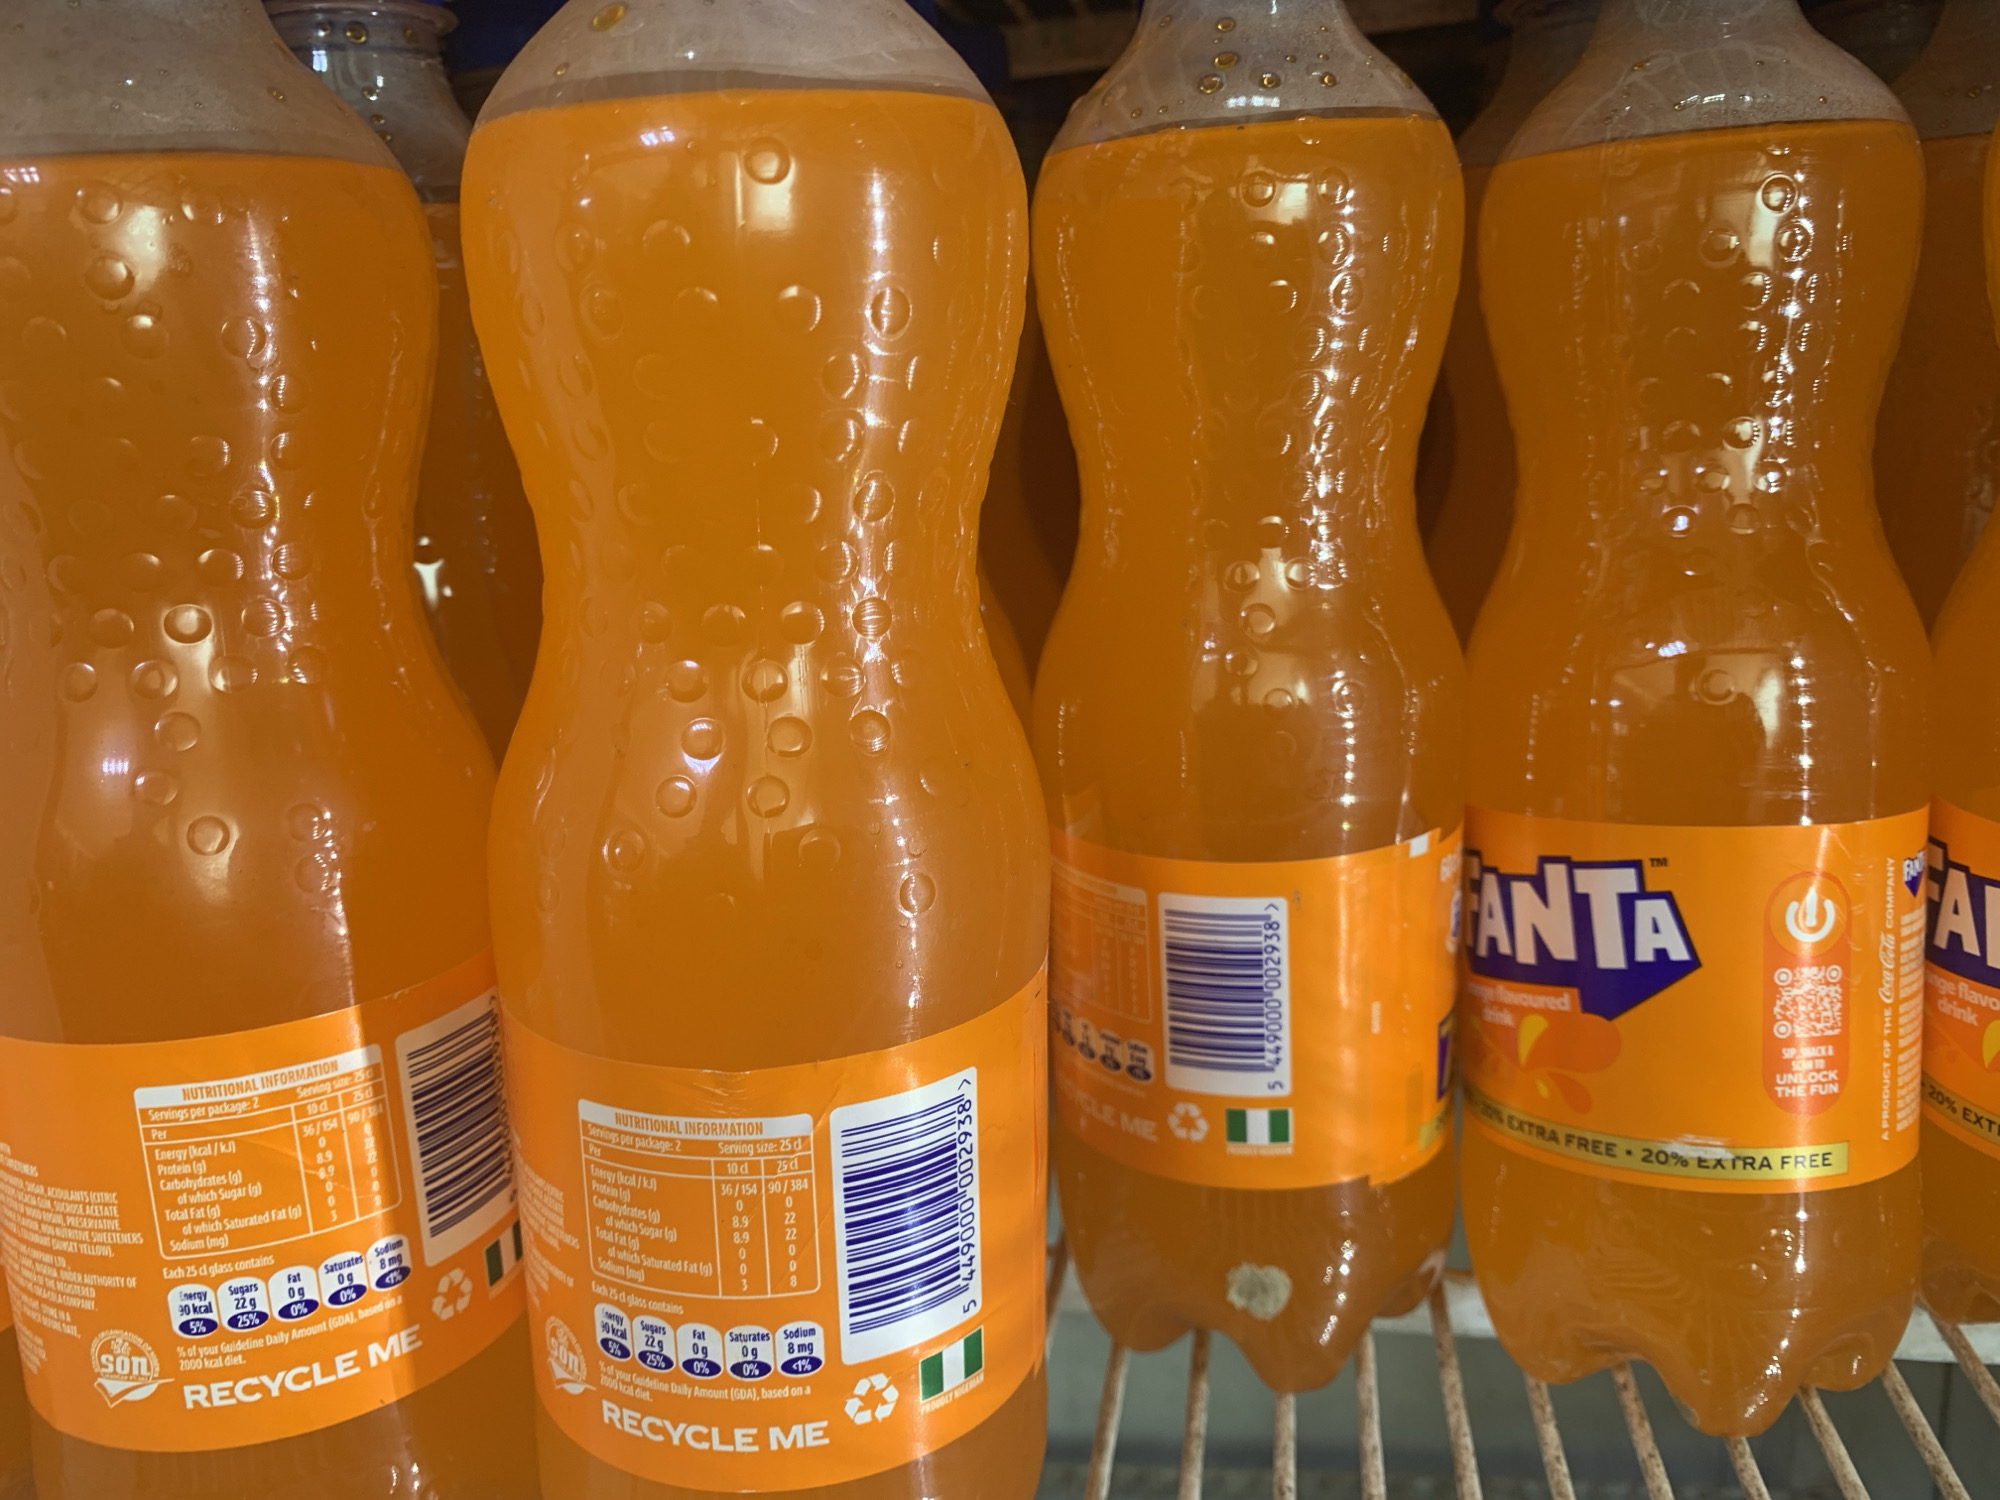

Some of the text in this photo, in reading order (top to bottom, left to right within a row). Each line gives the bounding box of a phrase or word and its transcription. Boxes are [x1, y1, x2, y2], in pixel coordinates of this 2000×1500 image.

[1649, 858, 1668, 867] TM
[1885, 857, 1895, 928] COMPANY
[1496, 983, 1571, 1011] flavoured
[1937, 996, 1979, 1027] drink
[1884, 1007, 1893, 1036] THE
[1883, 1040, 1892, 1058] OF
[182, 1060, 338, 1100] NUTRITIONAL INFORMATION
[1775, 1069, 1838, 1085] UNLOCK
[296, 1082, 332, 1099] Serving
[1774, 1082, 1839, 1098] THE FUN
[1881, 1062, 1891, 1128] PRODUCT
[1928, 1084, 1957, 1115] 20%
[148, 1100, 251, 1121] Servings per package:
[307, 1104, 318, 1115] 10
[615, 1112, 763, 1136] NUTRITIONAL INFORMATION
[1120, 1112, 1158, 1143] ME
[151, 1128, 167, 1140] Per
[588, 1123, 674, 1153] Servings per package:
[1506, 1115, 1560, 1145] EXTRA
[1564, 1133, 1618, 1158] FREE
[1641, 1147, 1689, 1168] 20%
[1697, 1154, 1773, 1170] EXTRA
[1780, 1151, 1833, 1170] FREE
[1881, 1130, 1890, 1141] A
[155, 1143, 212, 1161] Energy (kcal
[589, 1143, 601, 1157] Per
[718, 1139, 791, 1156] Serving size: 25
[157, 1160, 206, 1176] Protein (g)
[590, 1164, 615, 1184] Energy
[727, 1162, 737, 1174] 10
[777, 1161, 788, 1174] 25
[160, 1169, 242, 1191] Carbohydrates (g)
[591, 1180, 618, 1197] Protein
[768, 1178, 808, 1194] 90 384
[177, 1182, 262, 1205] of which Sugar (g)
[721, 1183, 757, 1196] 36 154
[165, 1204, 220, 1221] Total Fat (g)
[593, 1195, 647, 1220] Carbohydrates
[193, 1204, 302, 1233] which Saturated Fat (g)
[732, 1215, 749, 1228] 8.9
[784, 1211, 796, 1224] 22
[91, 1231, 143, 1244] SWEETENERS
[595, 1226, 640, 1251] Total Fat (g)
[614, 1218, 677, 1242] which Sugar (g)
[733, 1231, 750, 1244] 8.9
[785, 1227, 797, 1240] 22
[170, 1233, 229, 1251] Sodium (mg)
[374, 1239, 404, 1257] Sodium
[162, 1255, 275, 1279] Each 25 glass contains
[324, 1255, 364, 1275] Saturates
[598, 1256, 645, 1282] Sodium (mg)
[617, 1250, 712, 1277] which Saturated Fat (g)
[83, 1273, 125, 1287] AUTHORITY
[288, 1272, 301, 1283] Fat
[228, 1283, 259, 1296] Sugars
[340, 1288, 357, 1303] 0%
[591, 1280, 684, 1315] Each glass contains
[192, 1301, 214, 1315] kcal
[234, 1298, 247, 1310] 22
[290, 1302, 308, 1317] 0%
[189, 1320, 207, 1334] 5%
[237, 1312, 260, 1328] 25%
[640, 1320, 666, 1336] Sugars
[198, 1320, 327, 1358] your Guideline Daily Amount
[611, 1324, 627, 1340] kcal
[692, 1329, 706, 1341] Fat
[729, 1331, 771, 1343] Saturates
[783, 1327, 816, 1340] Sodium
[645, 1334, 656, 1348] 22
[797, 1342, 814, 1355] mg
[179, 1353, 247, 1371] 2000 kcal diet.
[183, 1324, 423, 1410] RECYCLE ME
[646, 1352, 666, 1369] 25%
[693, 1360, 710, 1375] 0%
[792, 1358, 812, 1372] <1%
[742, 1363, 760, 1377] 0%
[600, 1373, 618, 1390] 2000
[632, 1373, 802, 1402] Guideline Daily Amount (GDA), based on
[920, 1371, 984, 1415] PROUDLY NIGERIAN
[602, 1399, 830, 1452] RECYCLE ME
